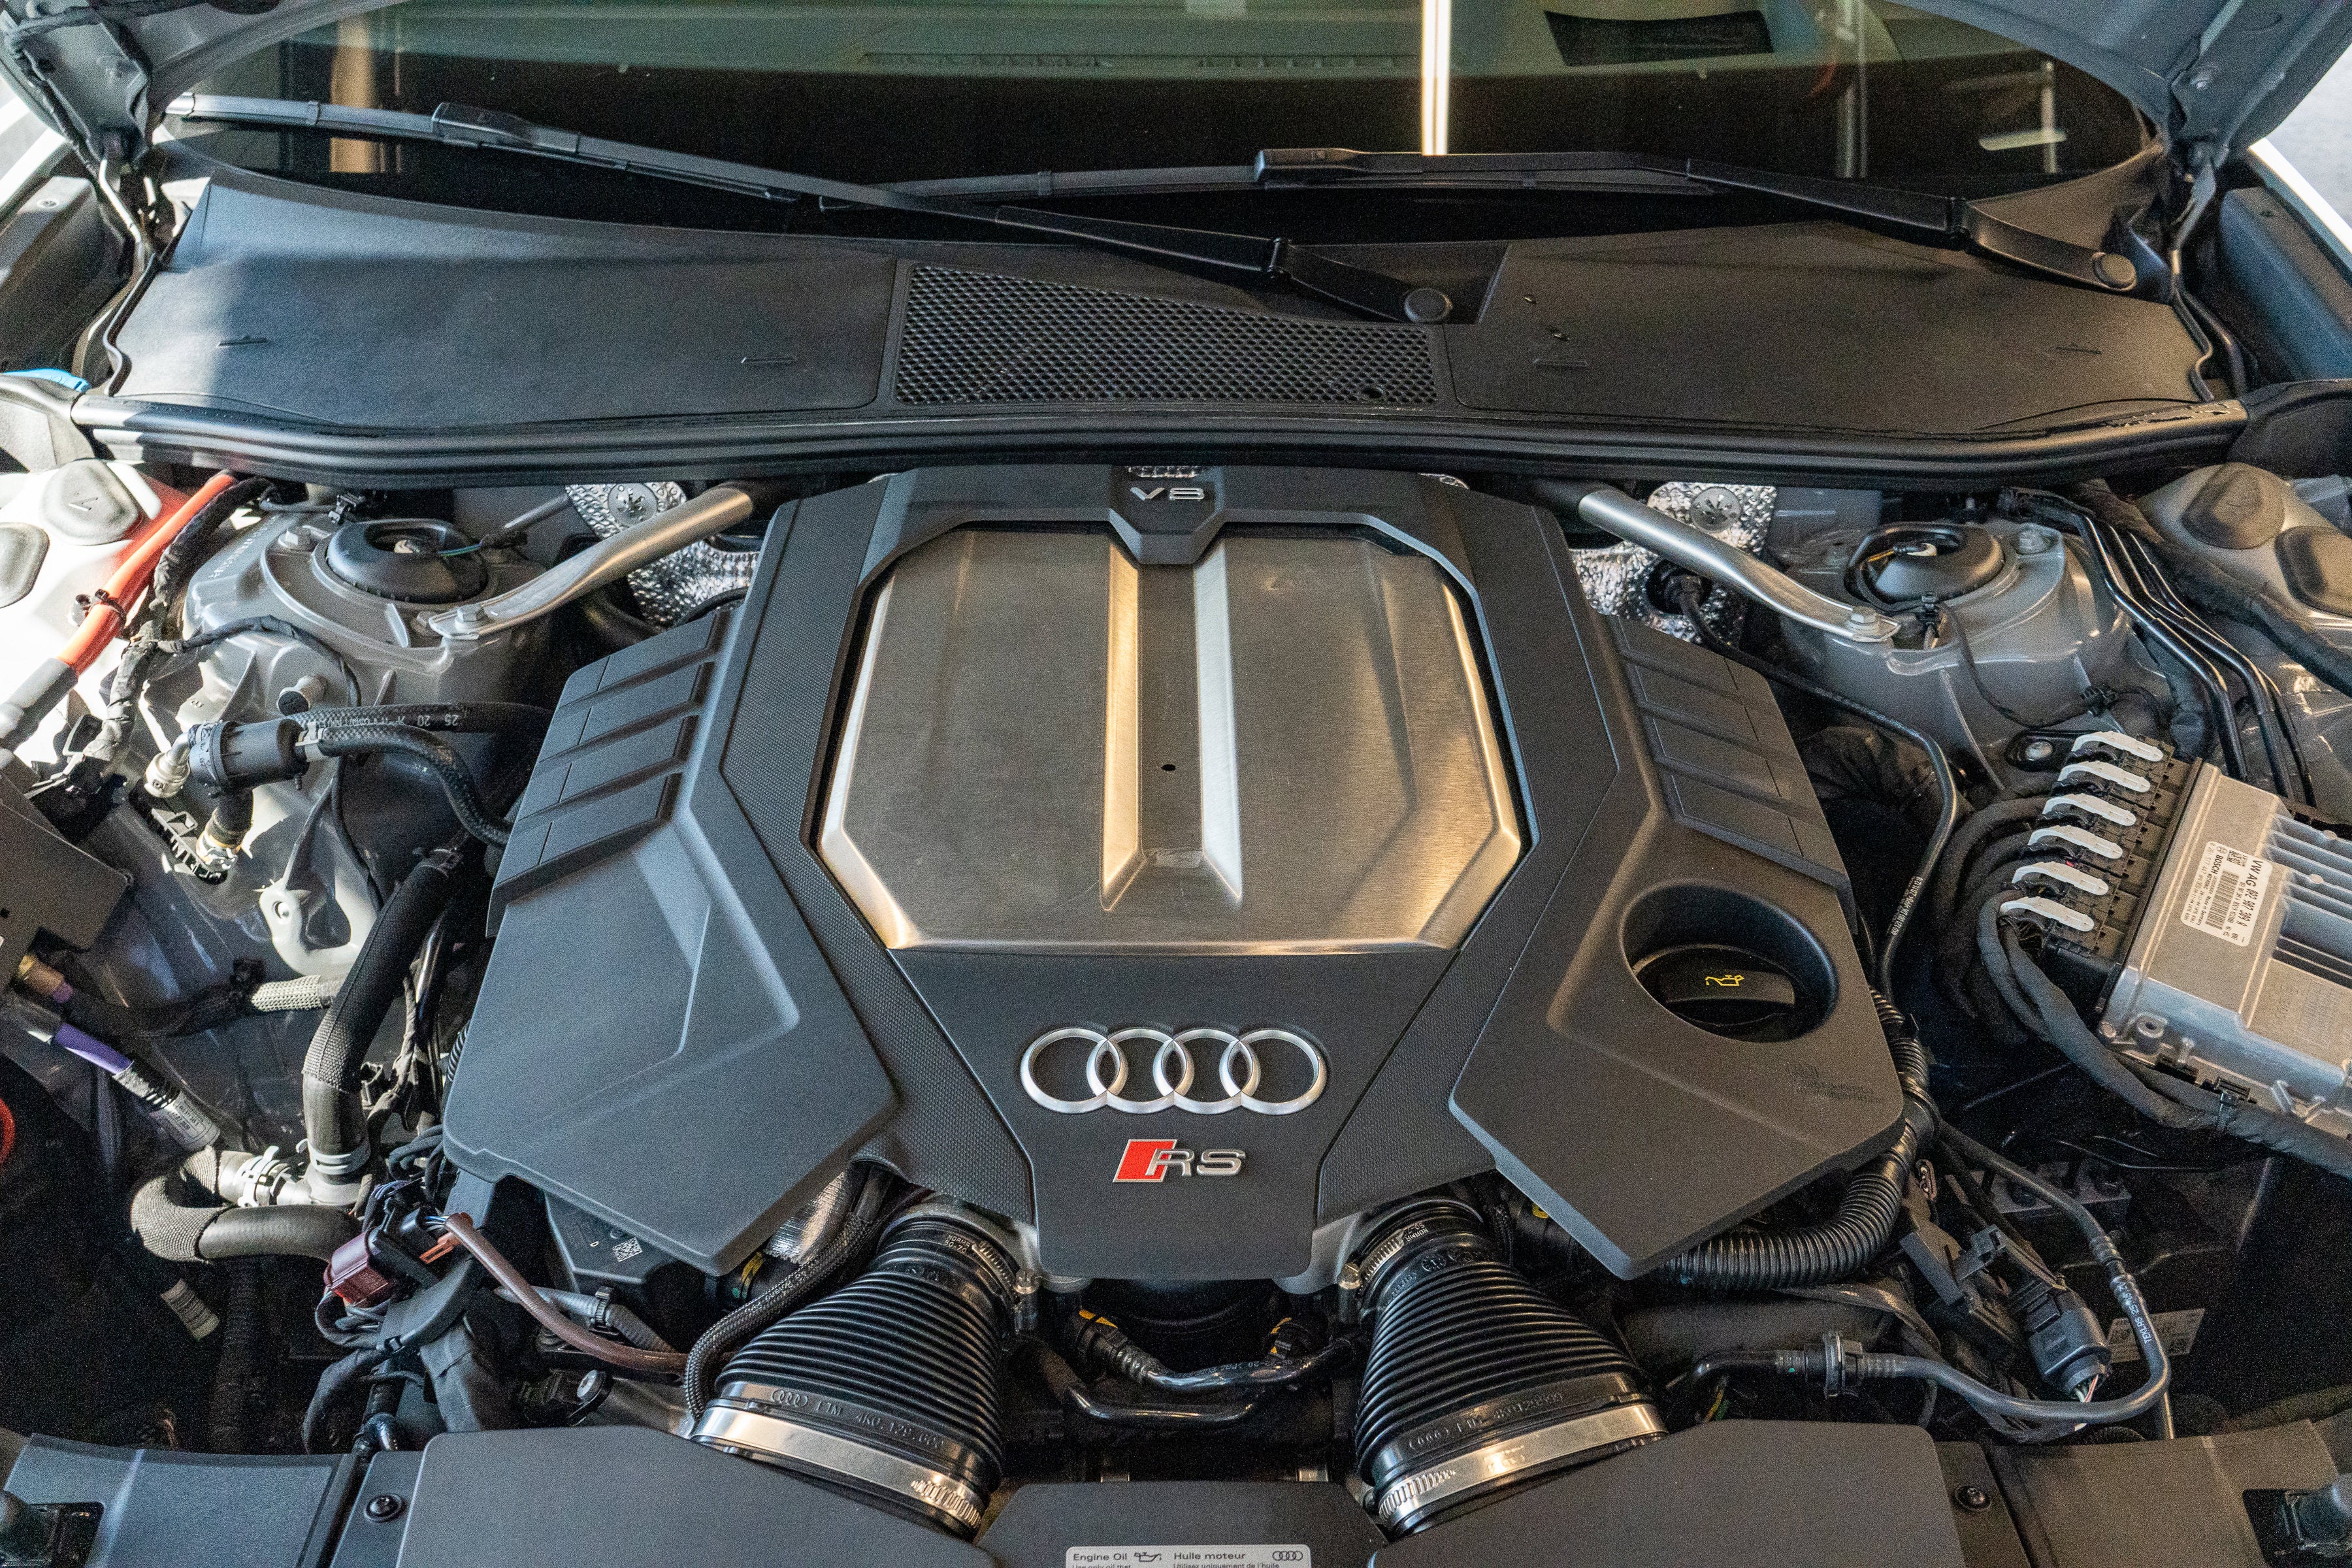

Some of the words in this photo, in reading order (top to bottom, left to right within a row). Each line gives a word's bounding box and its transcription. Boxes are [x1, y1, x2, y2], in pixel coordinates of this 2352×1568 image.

[1130, 487, 1205, 500] V8
[2210, 854, 2223, 874] BOSCH
[2249, 858, 2262, 874] VW
[2245, 873, 2259, 887] AG
[1144, 1147, 1246, 1179] RS
[947, 1235, 970, 1248] NORMA
[1407, 1227, 1429, 1242] NORMA
[2134, 1316, 2151, 1344] TEKLAS
[1073, 1554, 1109, 1562] Engine
